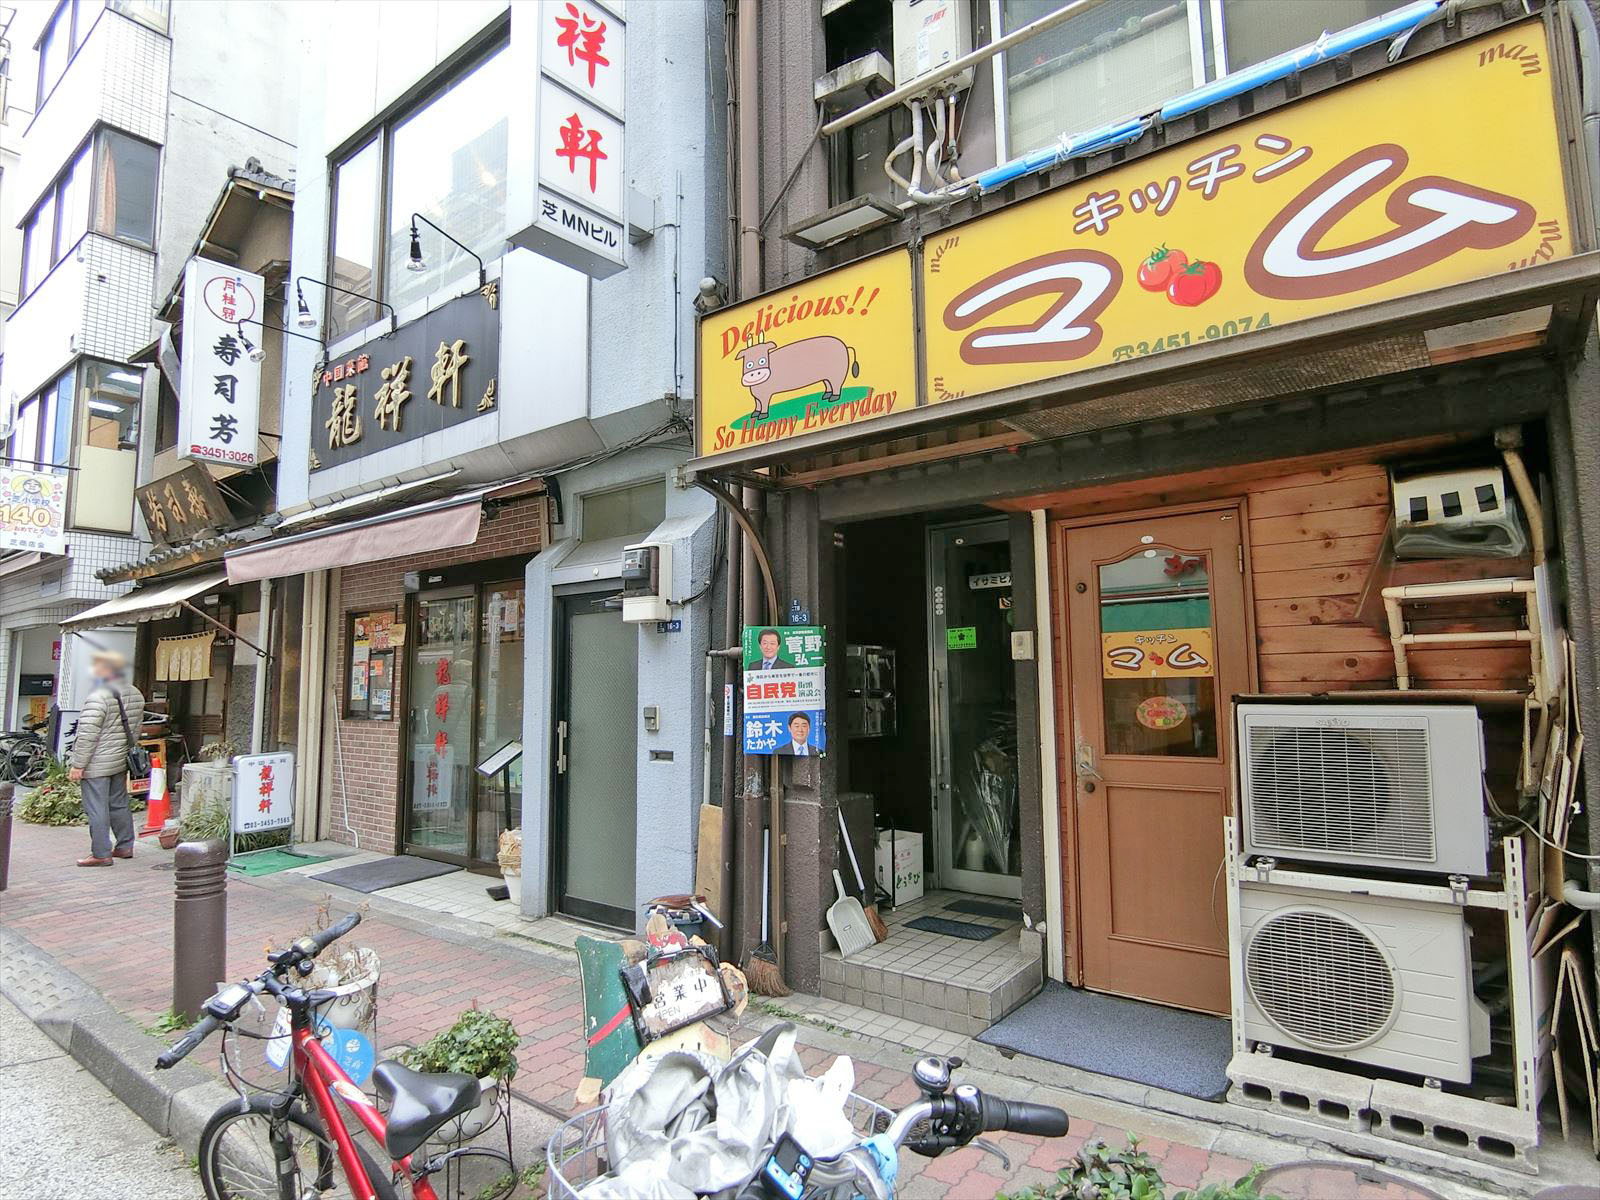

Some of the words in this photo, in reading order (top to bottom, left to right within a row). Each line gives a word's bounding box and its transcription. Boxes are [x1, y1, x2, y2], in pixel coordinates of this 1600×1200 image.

[1072, 133, 1313, 236] キッチン
[541, 199, 617, 248] 芝MNビル
[221, 279, 237, 321] 月桂冠
[720, 286, 880, 360] Delicious!!
[209, 333, 242, 445] 寿司芳
[325, 339, 470, 450] 龍祥軒
[713, 426, 735, 452] So
[739, 413, 799, 446] Happy
[802, 387, 897, 430] Everyday
[202, 445, 254, 463] 3451-3026
[0, 504, 51, 527] 140
[792, 614, 807, 622] 16-3
[785, 635, 822, 654] 菅野
[1135, 633, 1178, 645] キッチン
[794, 653, 823, 665] 弘一
[746, 682, 797, 700] 自民党
[746, 720, 783, 738] 鈴木
[746, 738, 777, 750] たかや
[653, 977, 708, 1009] 営業中
